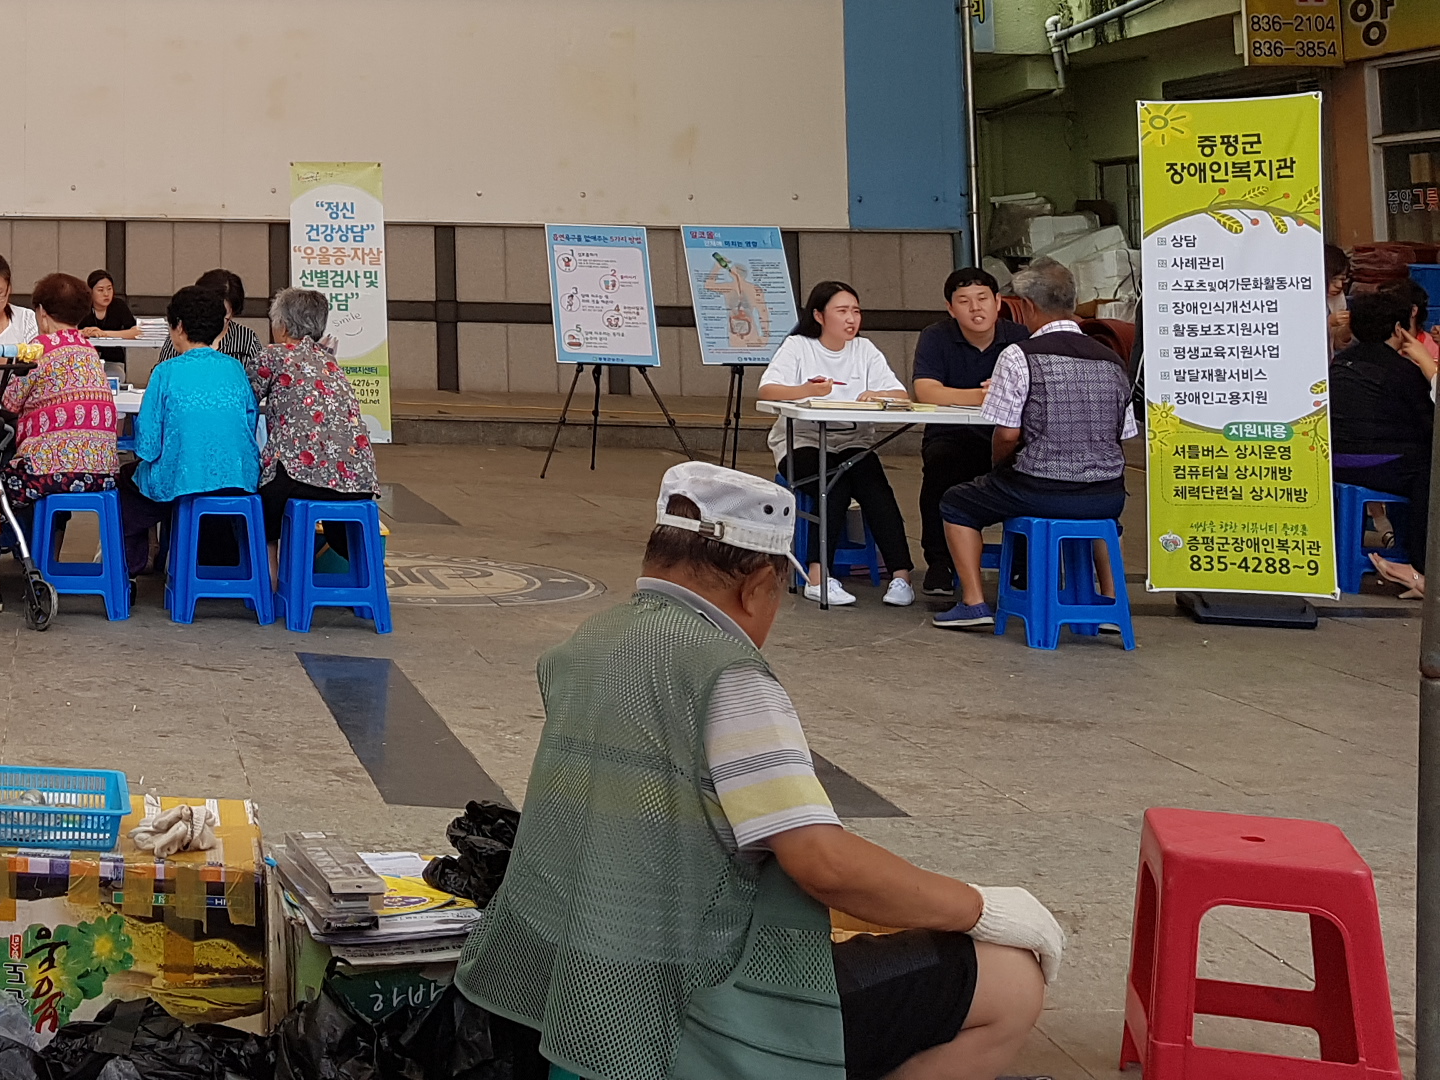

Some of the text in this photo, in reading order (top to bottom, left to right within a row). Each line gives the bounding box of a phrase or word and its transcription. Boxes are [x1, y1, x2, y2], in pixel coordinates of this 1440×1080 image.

[1249, 15, 1336, 32] 836-2104
[1252, 41, 1338, 58] 836-3854
[1197, 133, 1263, 158] 증평군
[1165, 157, 1296, 185] 장애인복지관
[1170, 235, 1197, 248] 상담
[1171, 256, 1224, 270] 사례관리
[299, 270, 379, 289] 선별검사 및
[1171, 276, 1312, 292] 스포츠및여가문화활동사업
[1172, 300, 1279, 315] 장애인식개선사업
[1172, 322, 1280, 337] 활동보조지원사업
[1173, 345, 1280, 360] 평생교육지원사업
[1173, 369, 1268, 382] 발달재활서비스
[1174, 391, 1268, 405] 장애인고용지원
[1228, 423, 1288, 439] 지원내용
[1172, 445, 1292, 460] 셔틀버스 상시운영
[1172, 465, 1292, 481] 컴퓨터실 상시개방
[1173, 486, 1308, 503] 체력단련실 상시개방
[1186, 535, 1321, 556] 증평군장애인복지관
[1189, 554, 1320, 576] 835-4288~9
